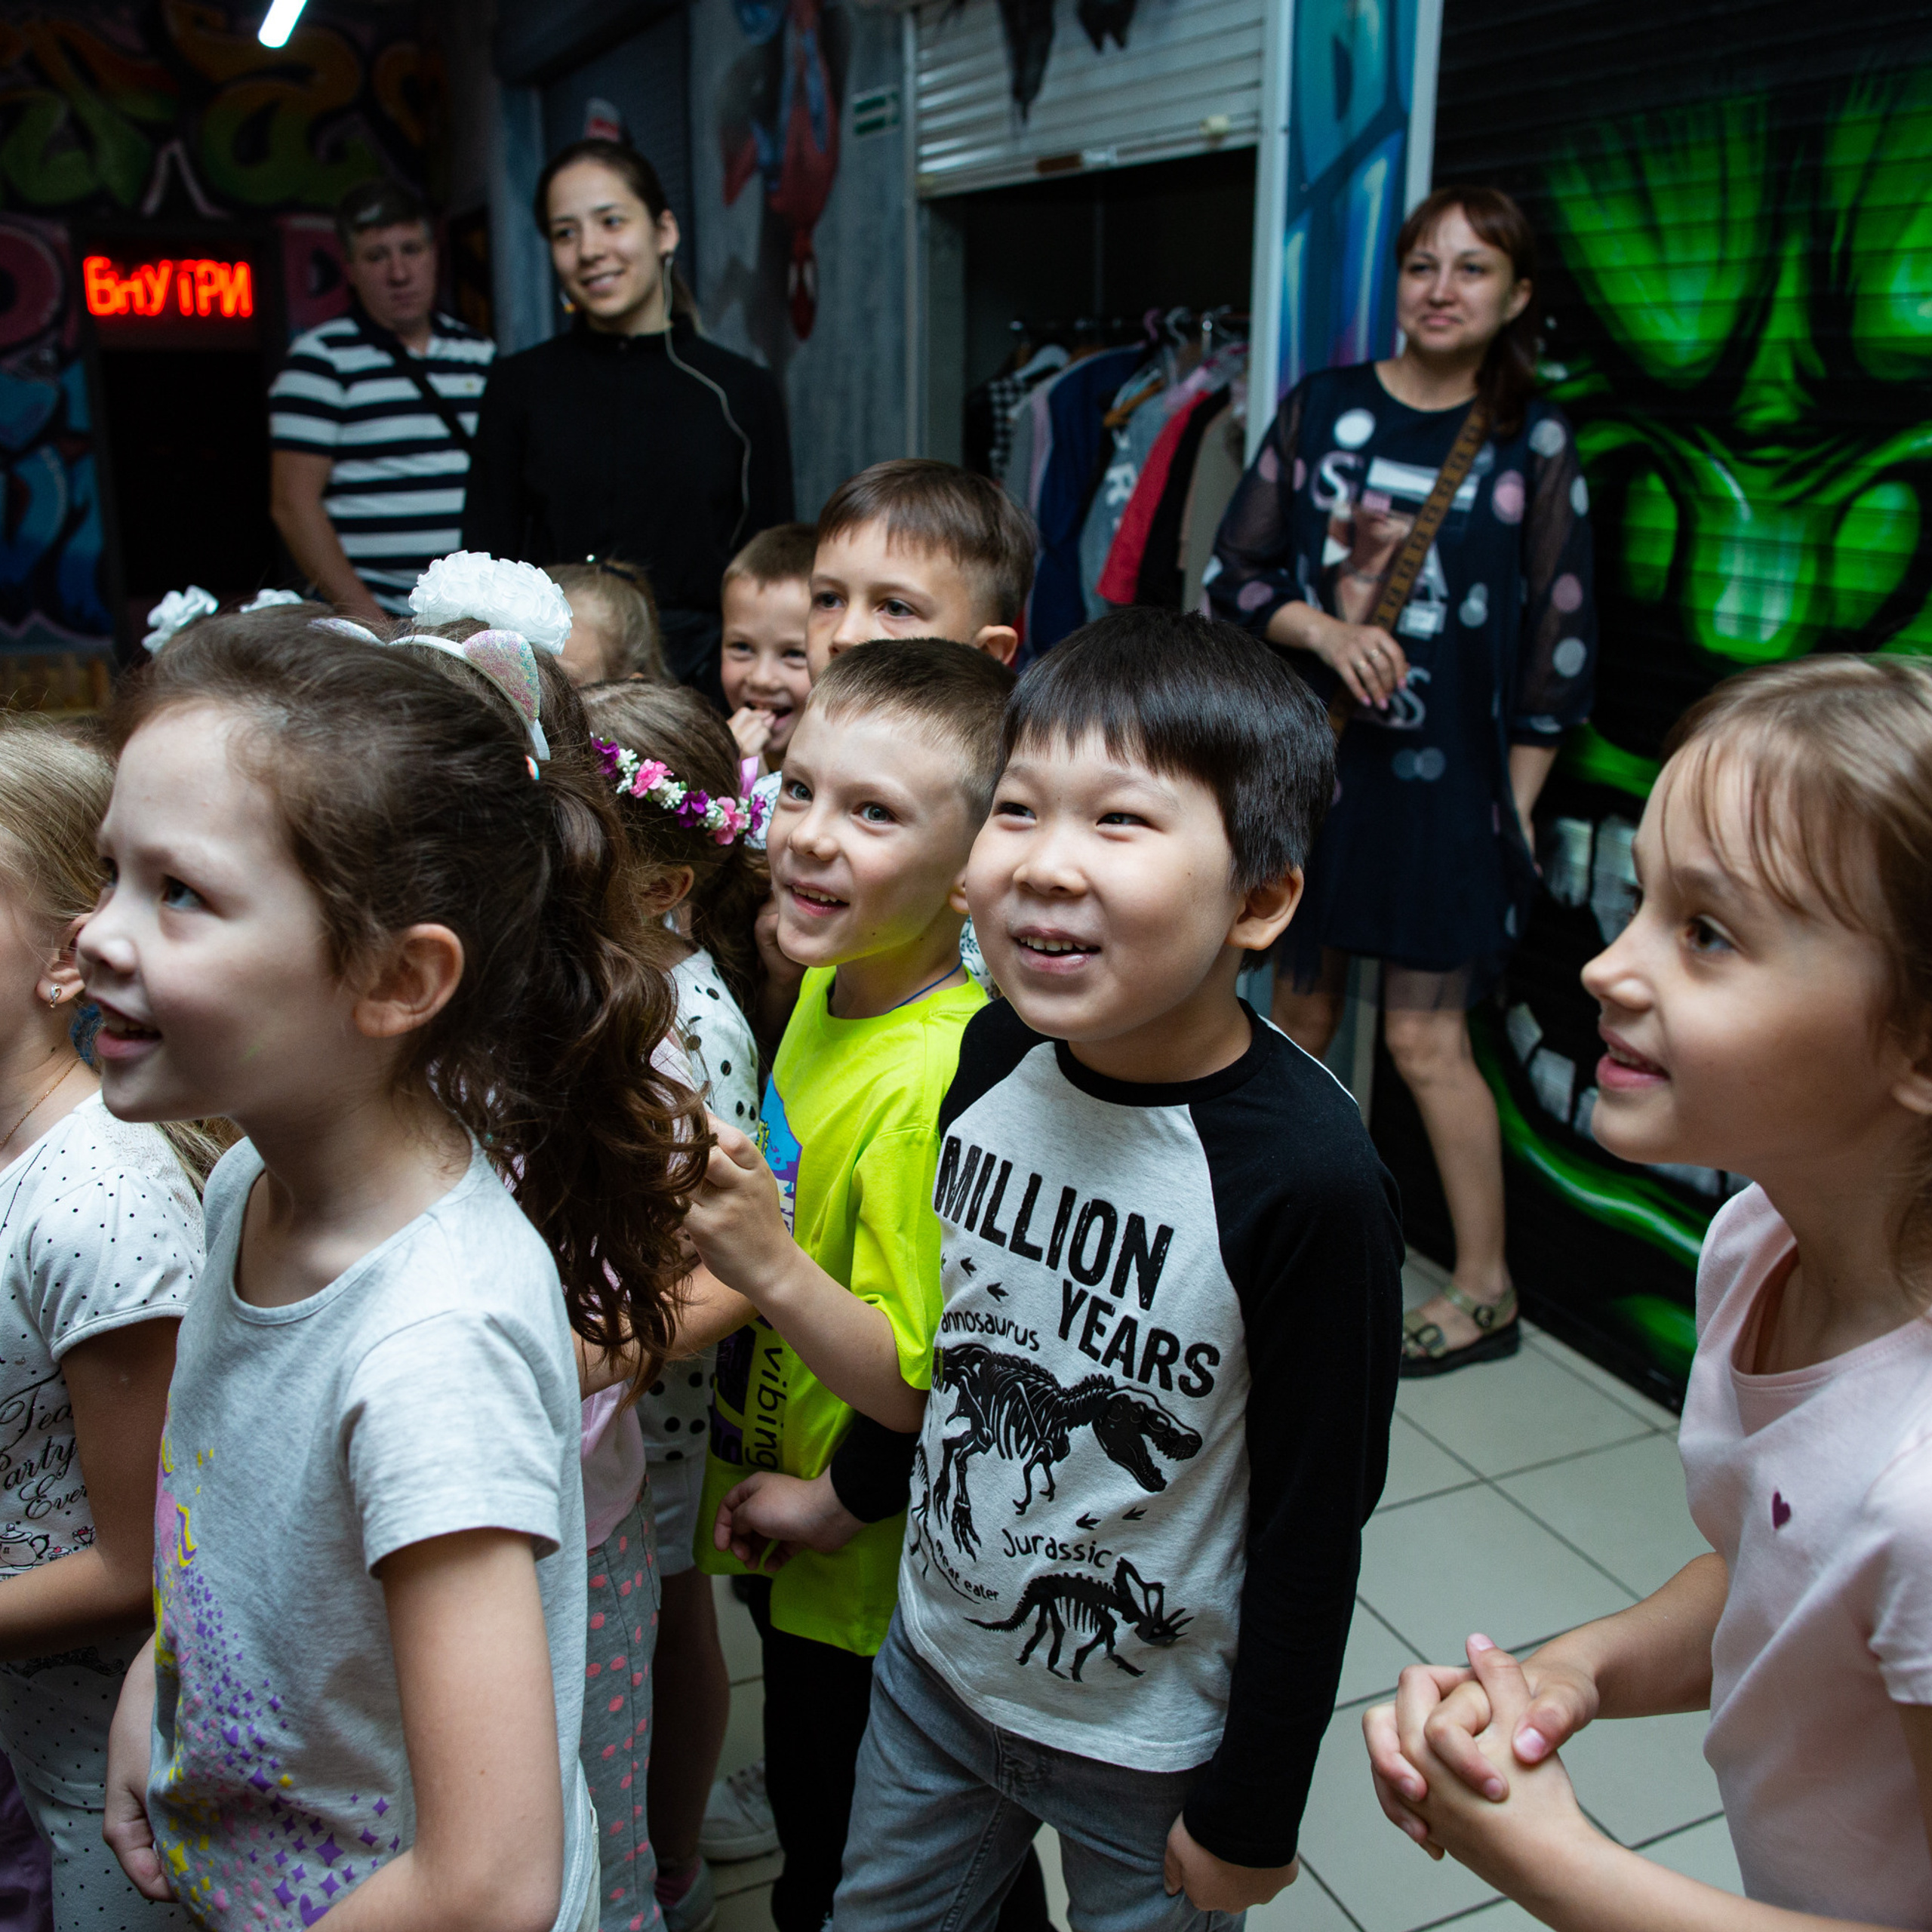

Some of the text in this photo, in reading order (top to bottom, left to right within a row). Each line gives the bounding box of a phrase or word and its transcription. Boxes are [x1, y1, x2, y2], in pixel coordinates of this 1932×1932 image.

[934, 1135, 1174, 1311] MILLION
[1058, 1278, 1220, 1398] YEARS
[0, 1364, 74, 1452] Tea
[745, 1347, 788, 1471] vibing
[964, 1580, 999, 1601] eater
[1001, 1528, 1112, 1568] Jurassic
